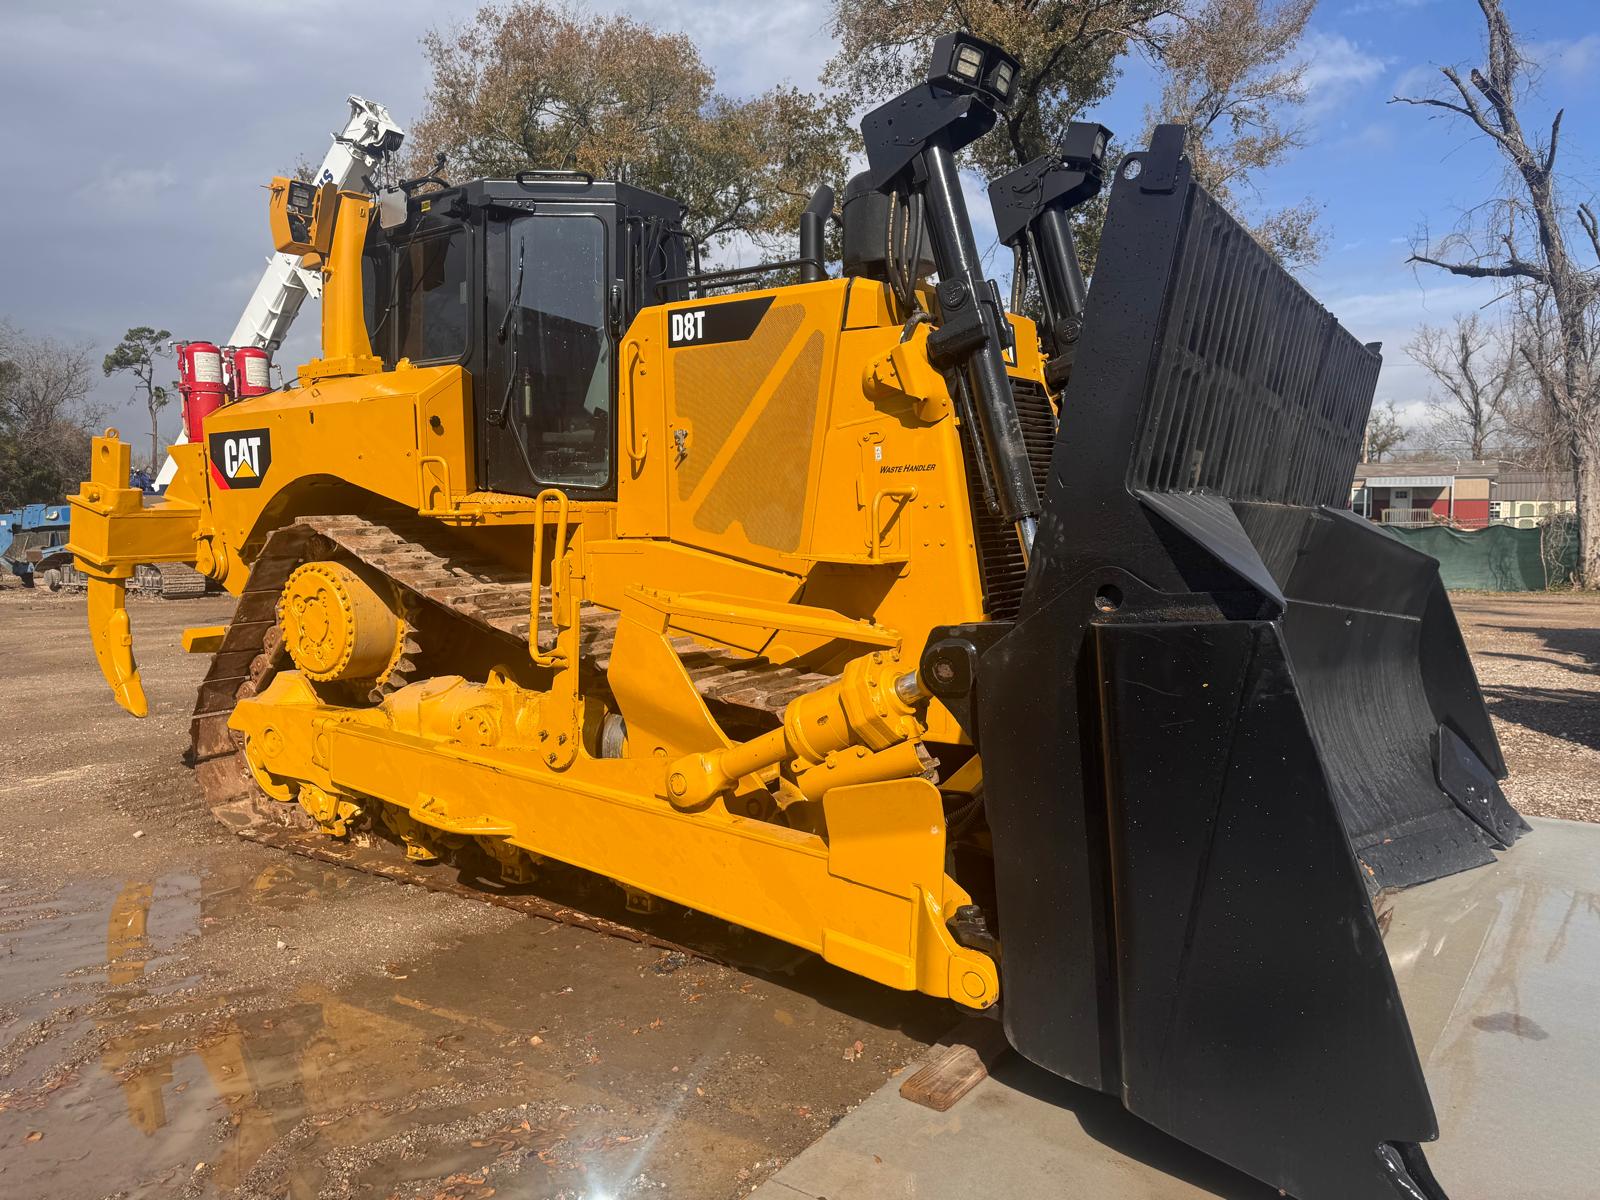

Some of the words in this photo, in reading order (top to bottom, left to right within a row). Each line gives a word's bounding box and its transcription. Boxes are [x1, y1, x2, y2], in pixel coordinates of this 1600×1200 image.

[672, 310, 706, 342] D8T
[224, 436, 261, 479] CAT
[879, 465, 904, 474] WASTE
[903, 463, 937, 473] HANDLER
